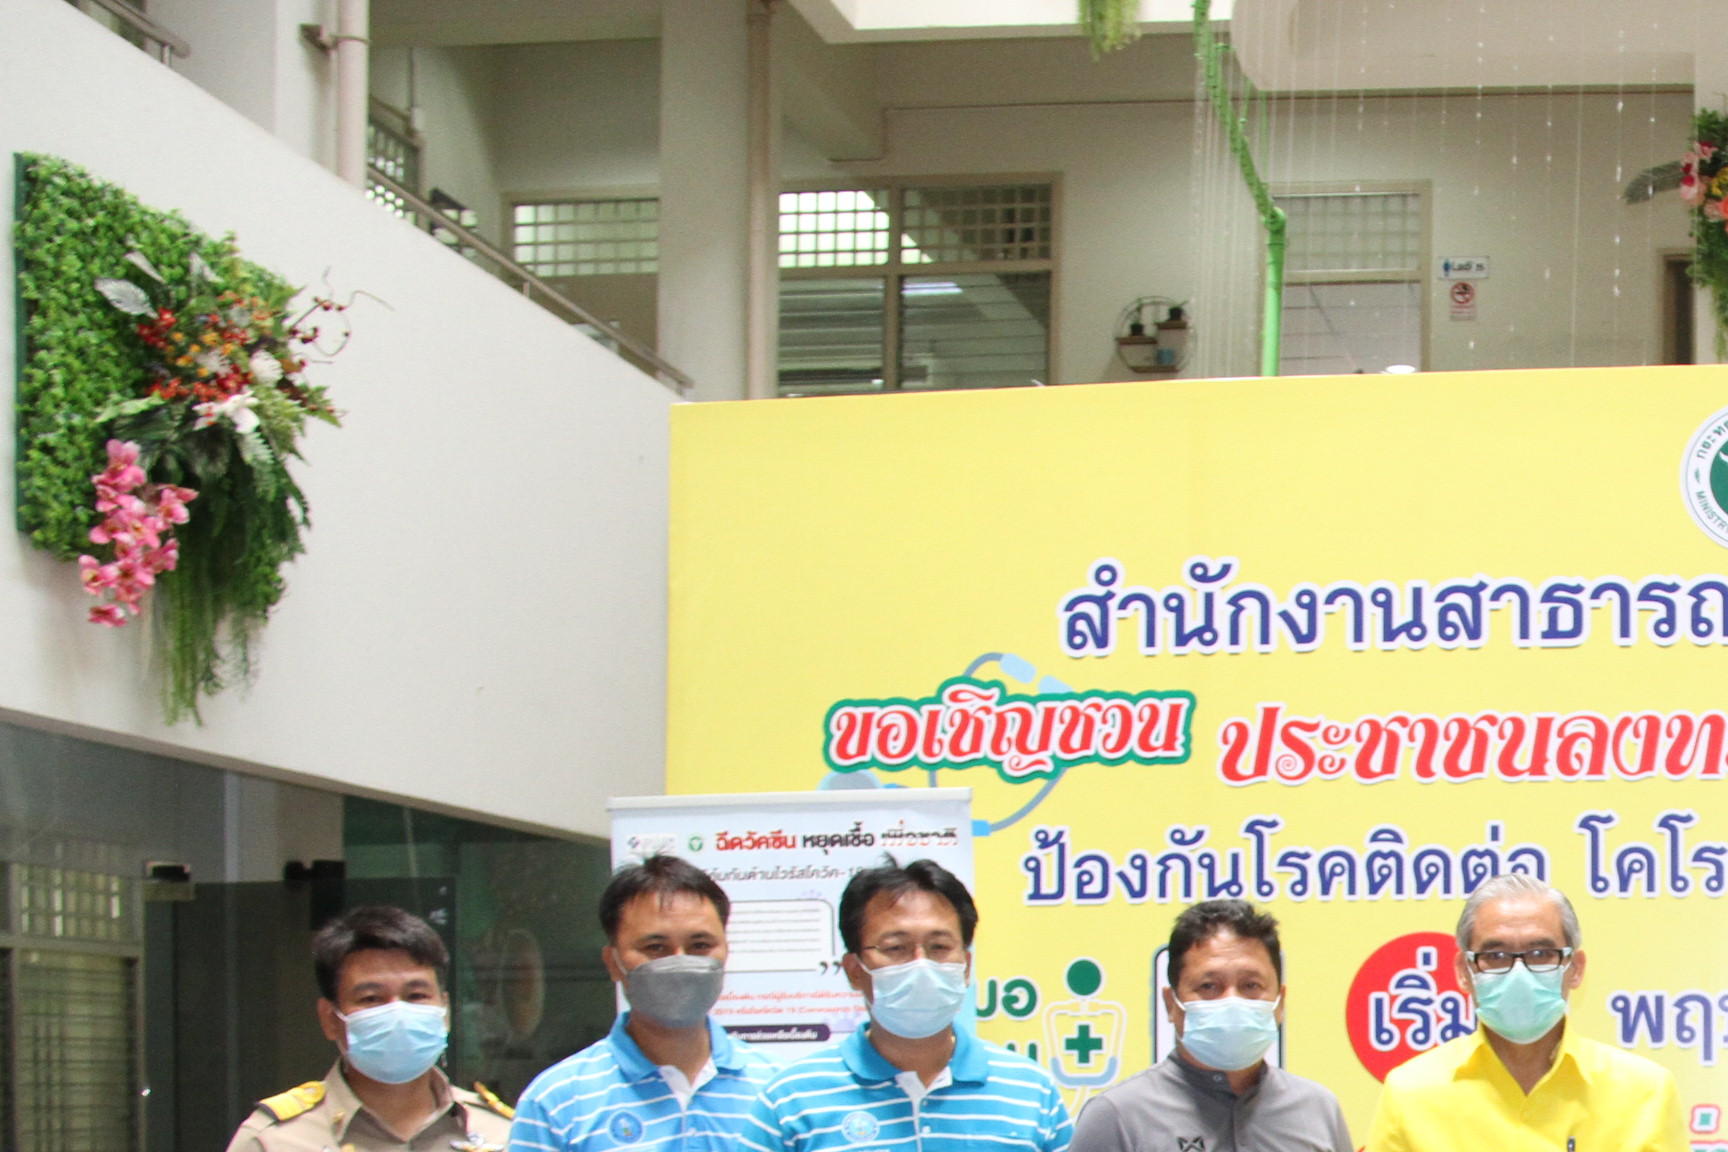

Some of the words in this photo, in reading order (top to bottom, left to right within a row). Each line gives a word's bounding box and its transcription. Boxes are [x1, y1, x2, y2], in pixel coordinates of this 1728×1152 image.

[836, 686, 1182, 772] ขอเชิญชวน
[715, 830, 797, 851] ฉีดวัคซีน
[802, 822, 876, 855] หยุดเชื้อ
[1024, 819, 1546, 901] ป้องกันโรคติดต่อ
